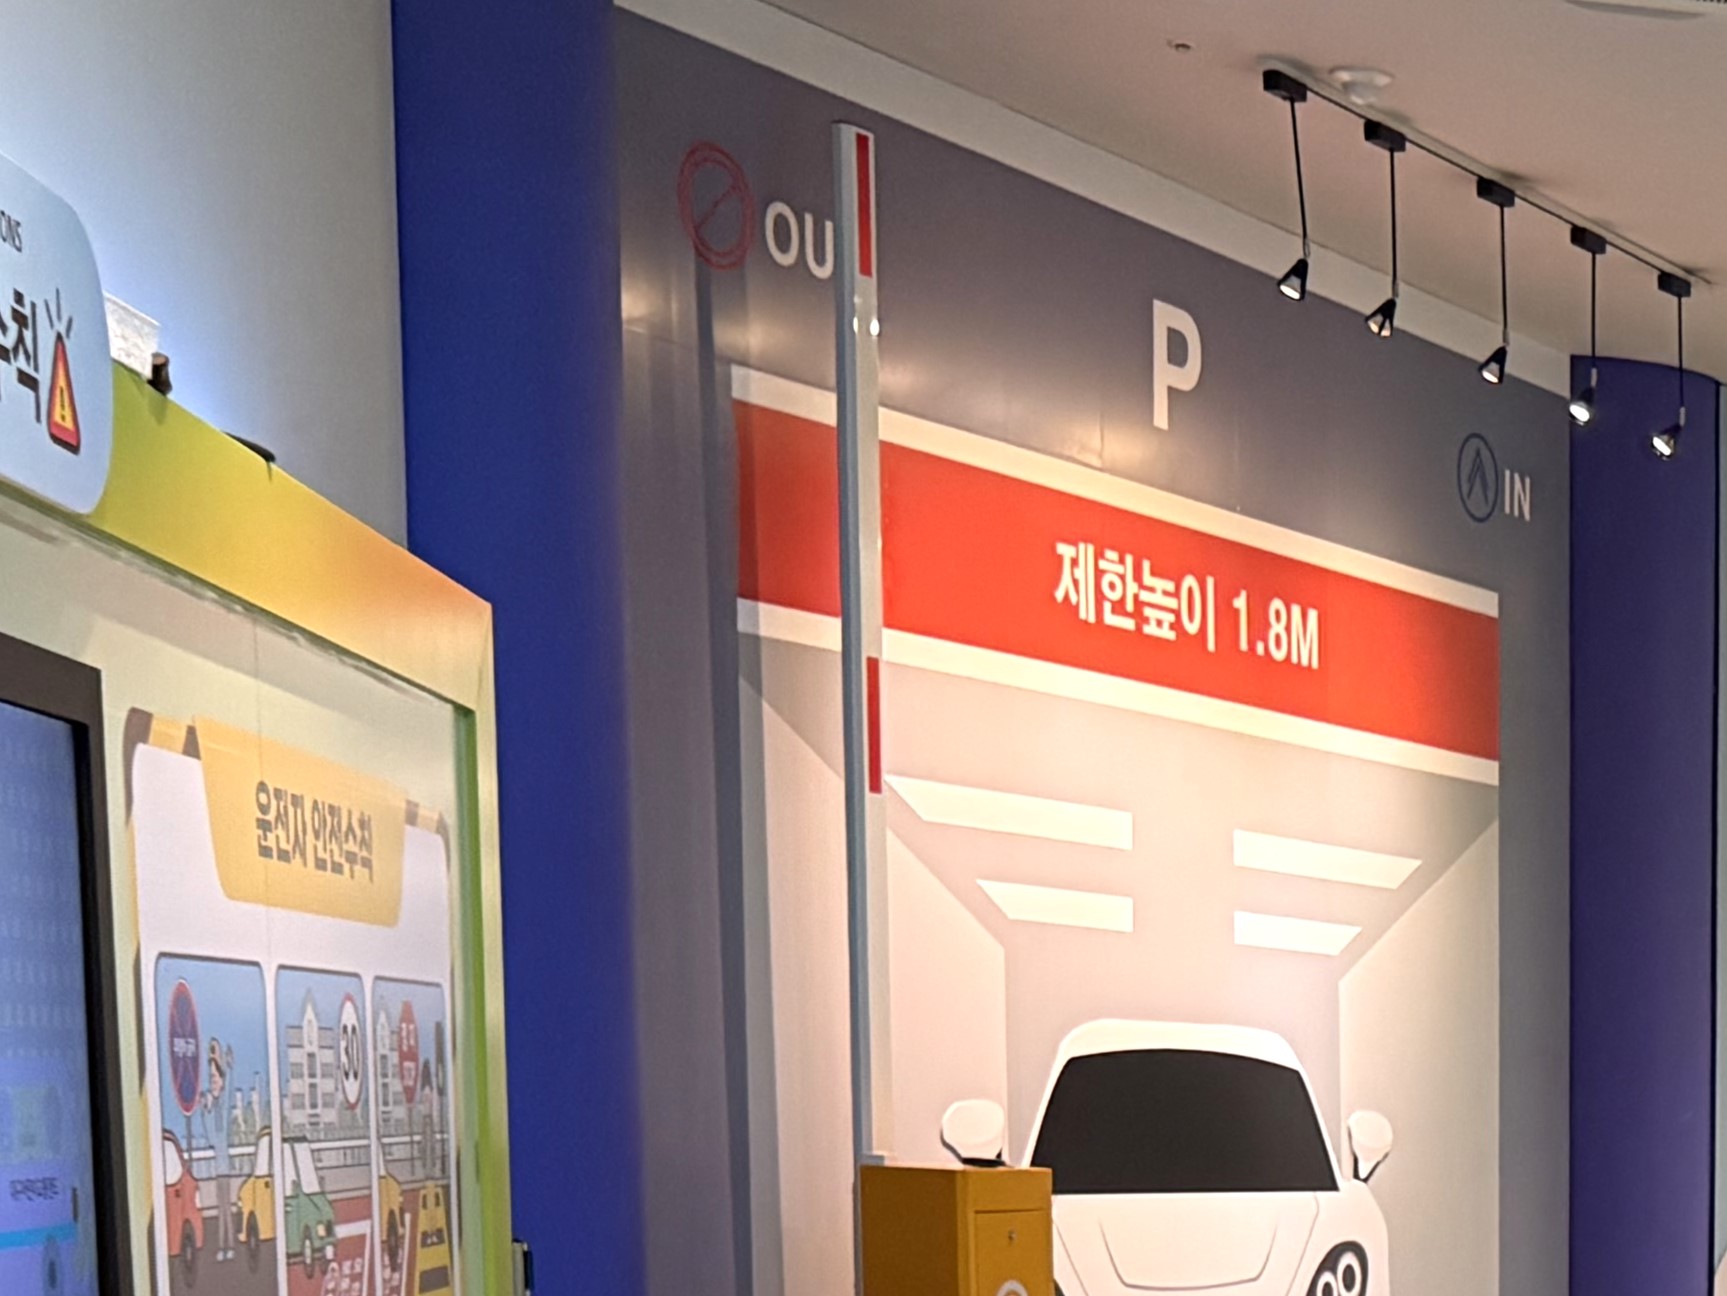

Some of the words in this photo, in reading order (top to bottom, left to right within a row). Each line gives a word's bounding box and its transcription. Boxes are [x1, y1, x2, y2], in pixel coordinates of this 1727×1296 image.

[766, 202, 835, 279] OU
[1153, 299, 1202, 430] P
[1504, 468, 1532, 522] IN
[1055, 541, 1216, 653] 제한높이
[1232, 589, 1319, 670] 1.8M
[256, 780, 307, 868] 운전자
[312, 799, 373, 884] 안전수칙
[341, 1024, 360, 1081] 30
